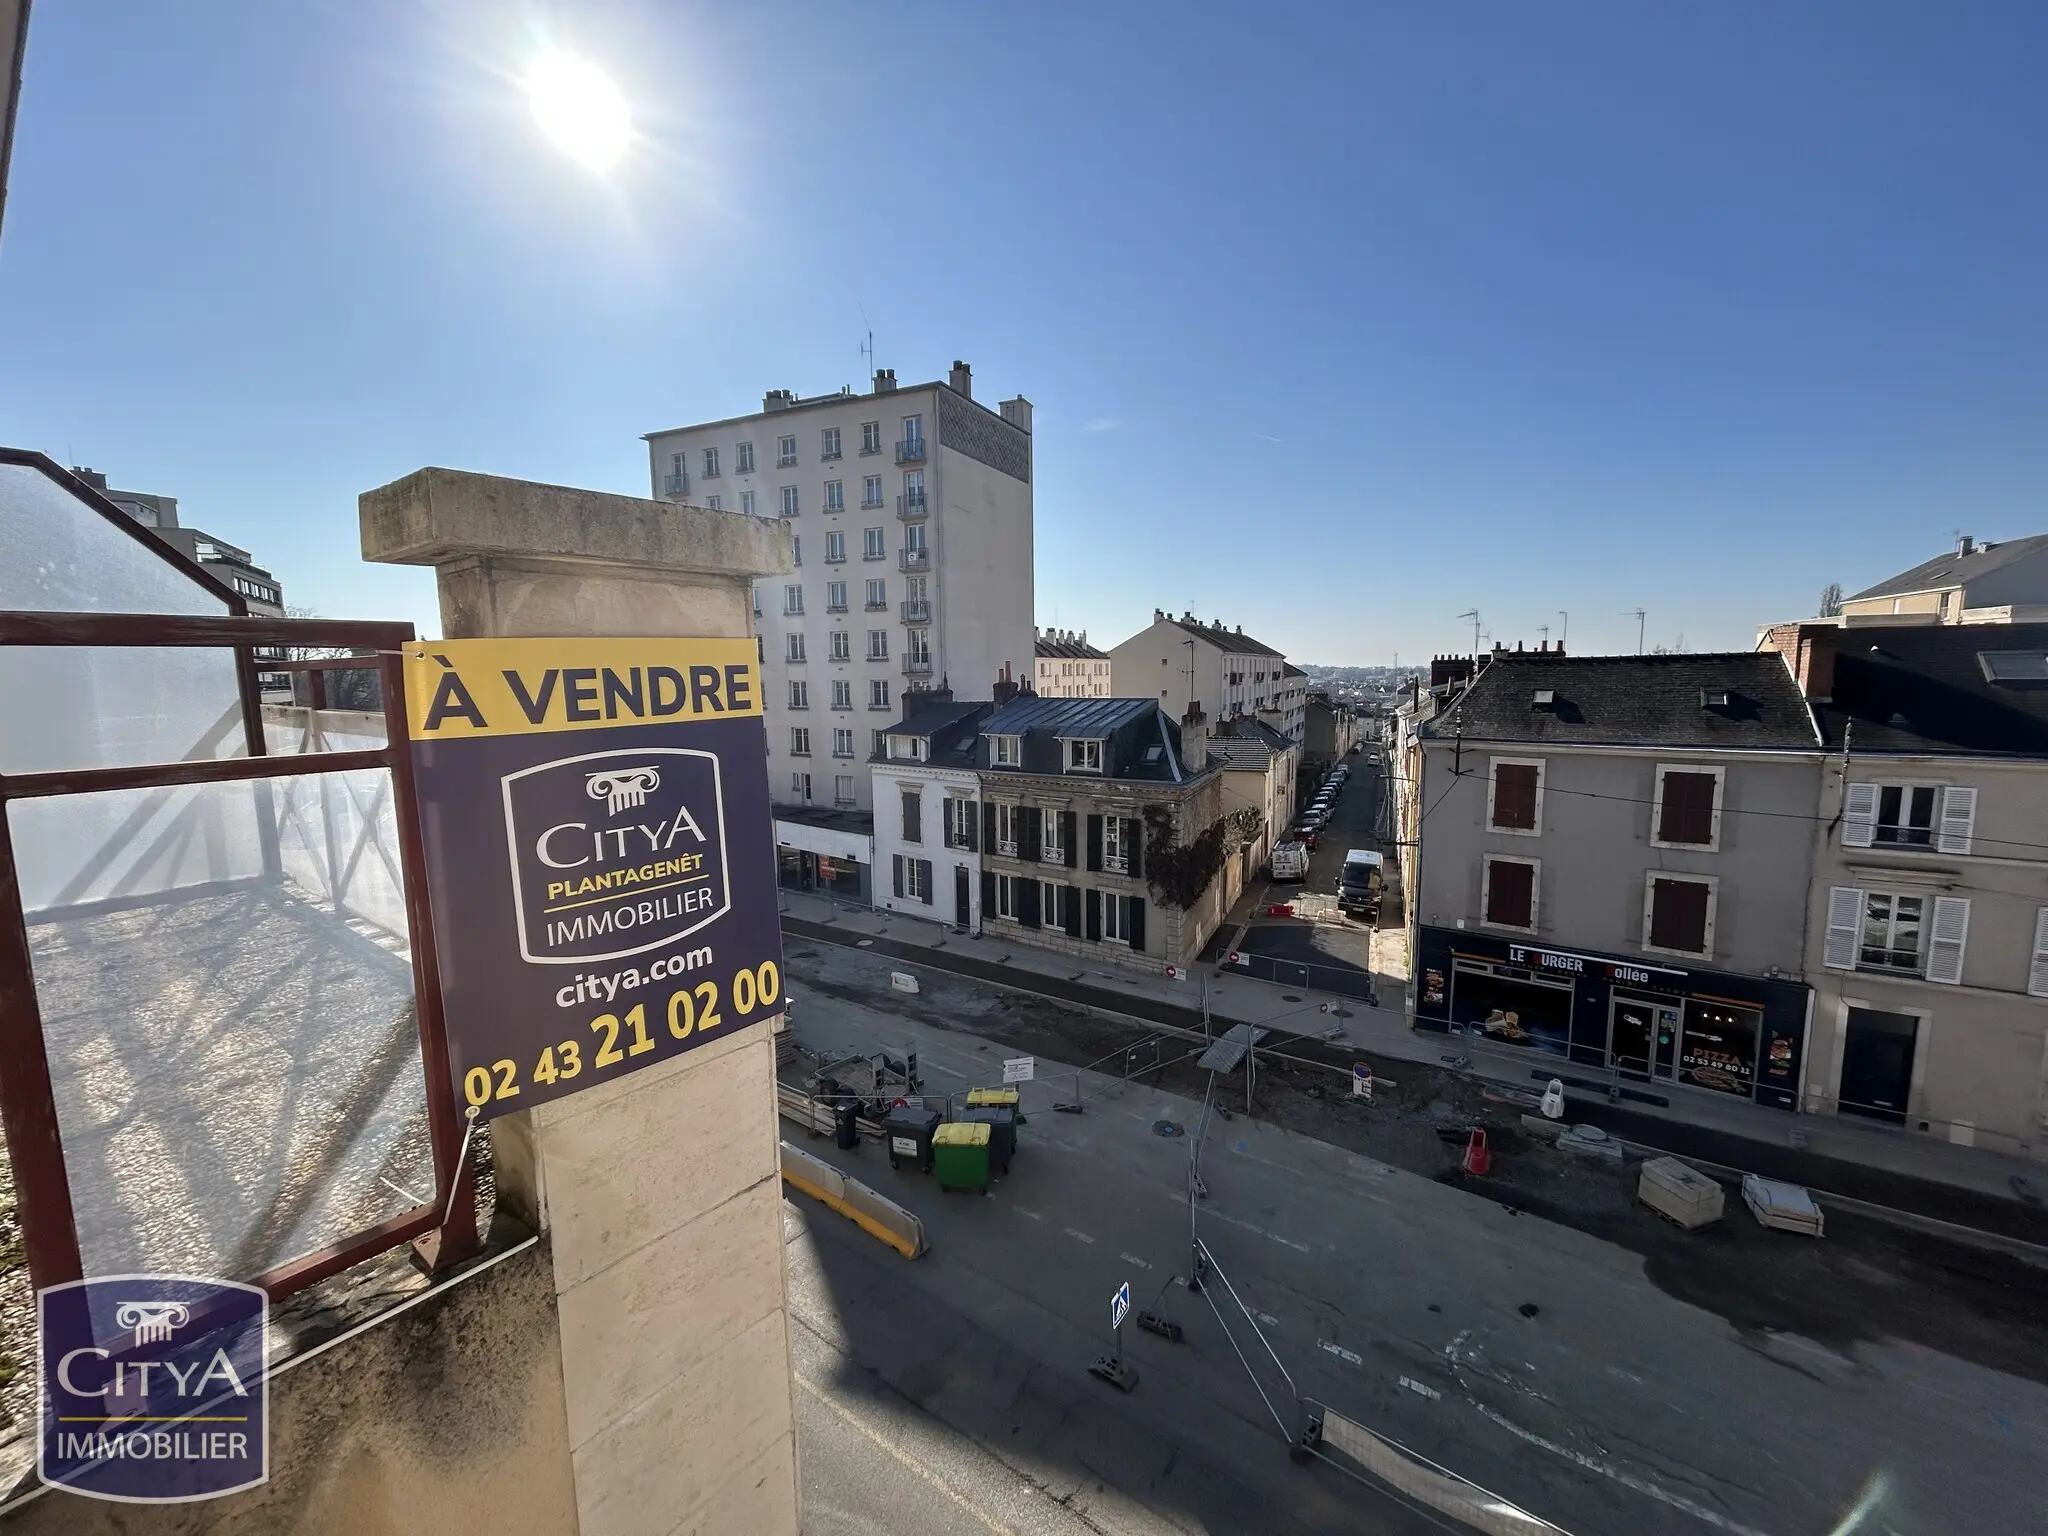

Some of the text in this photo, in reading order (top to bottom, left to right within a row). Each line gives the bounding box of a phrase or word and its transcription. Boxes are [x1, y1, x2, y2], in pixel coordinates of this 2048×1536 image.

[423, 655, 752, 730] À VENDRE
[536, 805, 707, 869] CITYA
[547, 853, 703, 900] PLANTAGENÊT
[547, 887, 713, 947] IMMOBILIER
[555, 945, 713, 1008] citya.com
[1509, 949, 1525, 962] LE
[464, 960, 780, 1106] 02 43 21 02 00
[1683, 1055, 1695, 1063] 02
[1710, 1061, 1723, 1069] 49
[1693, 1048, 1742, 1066] PIZZA
